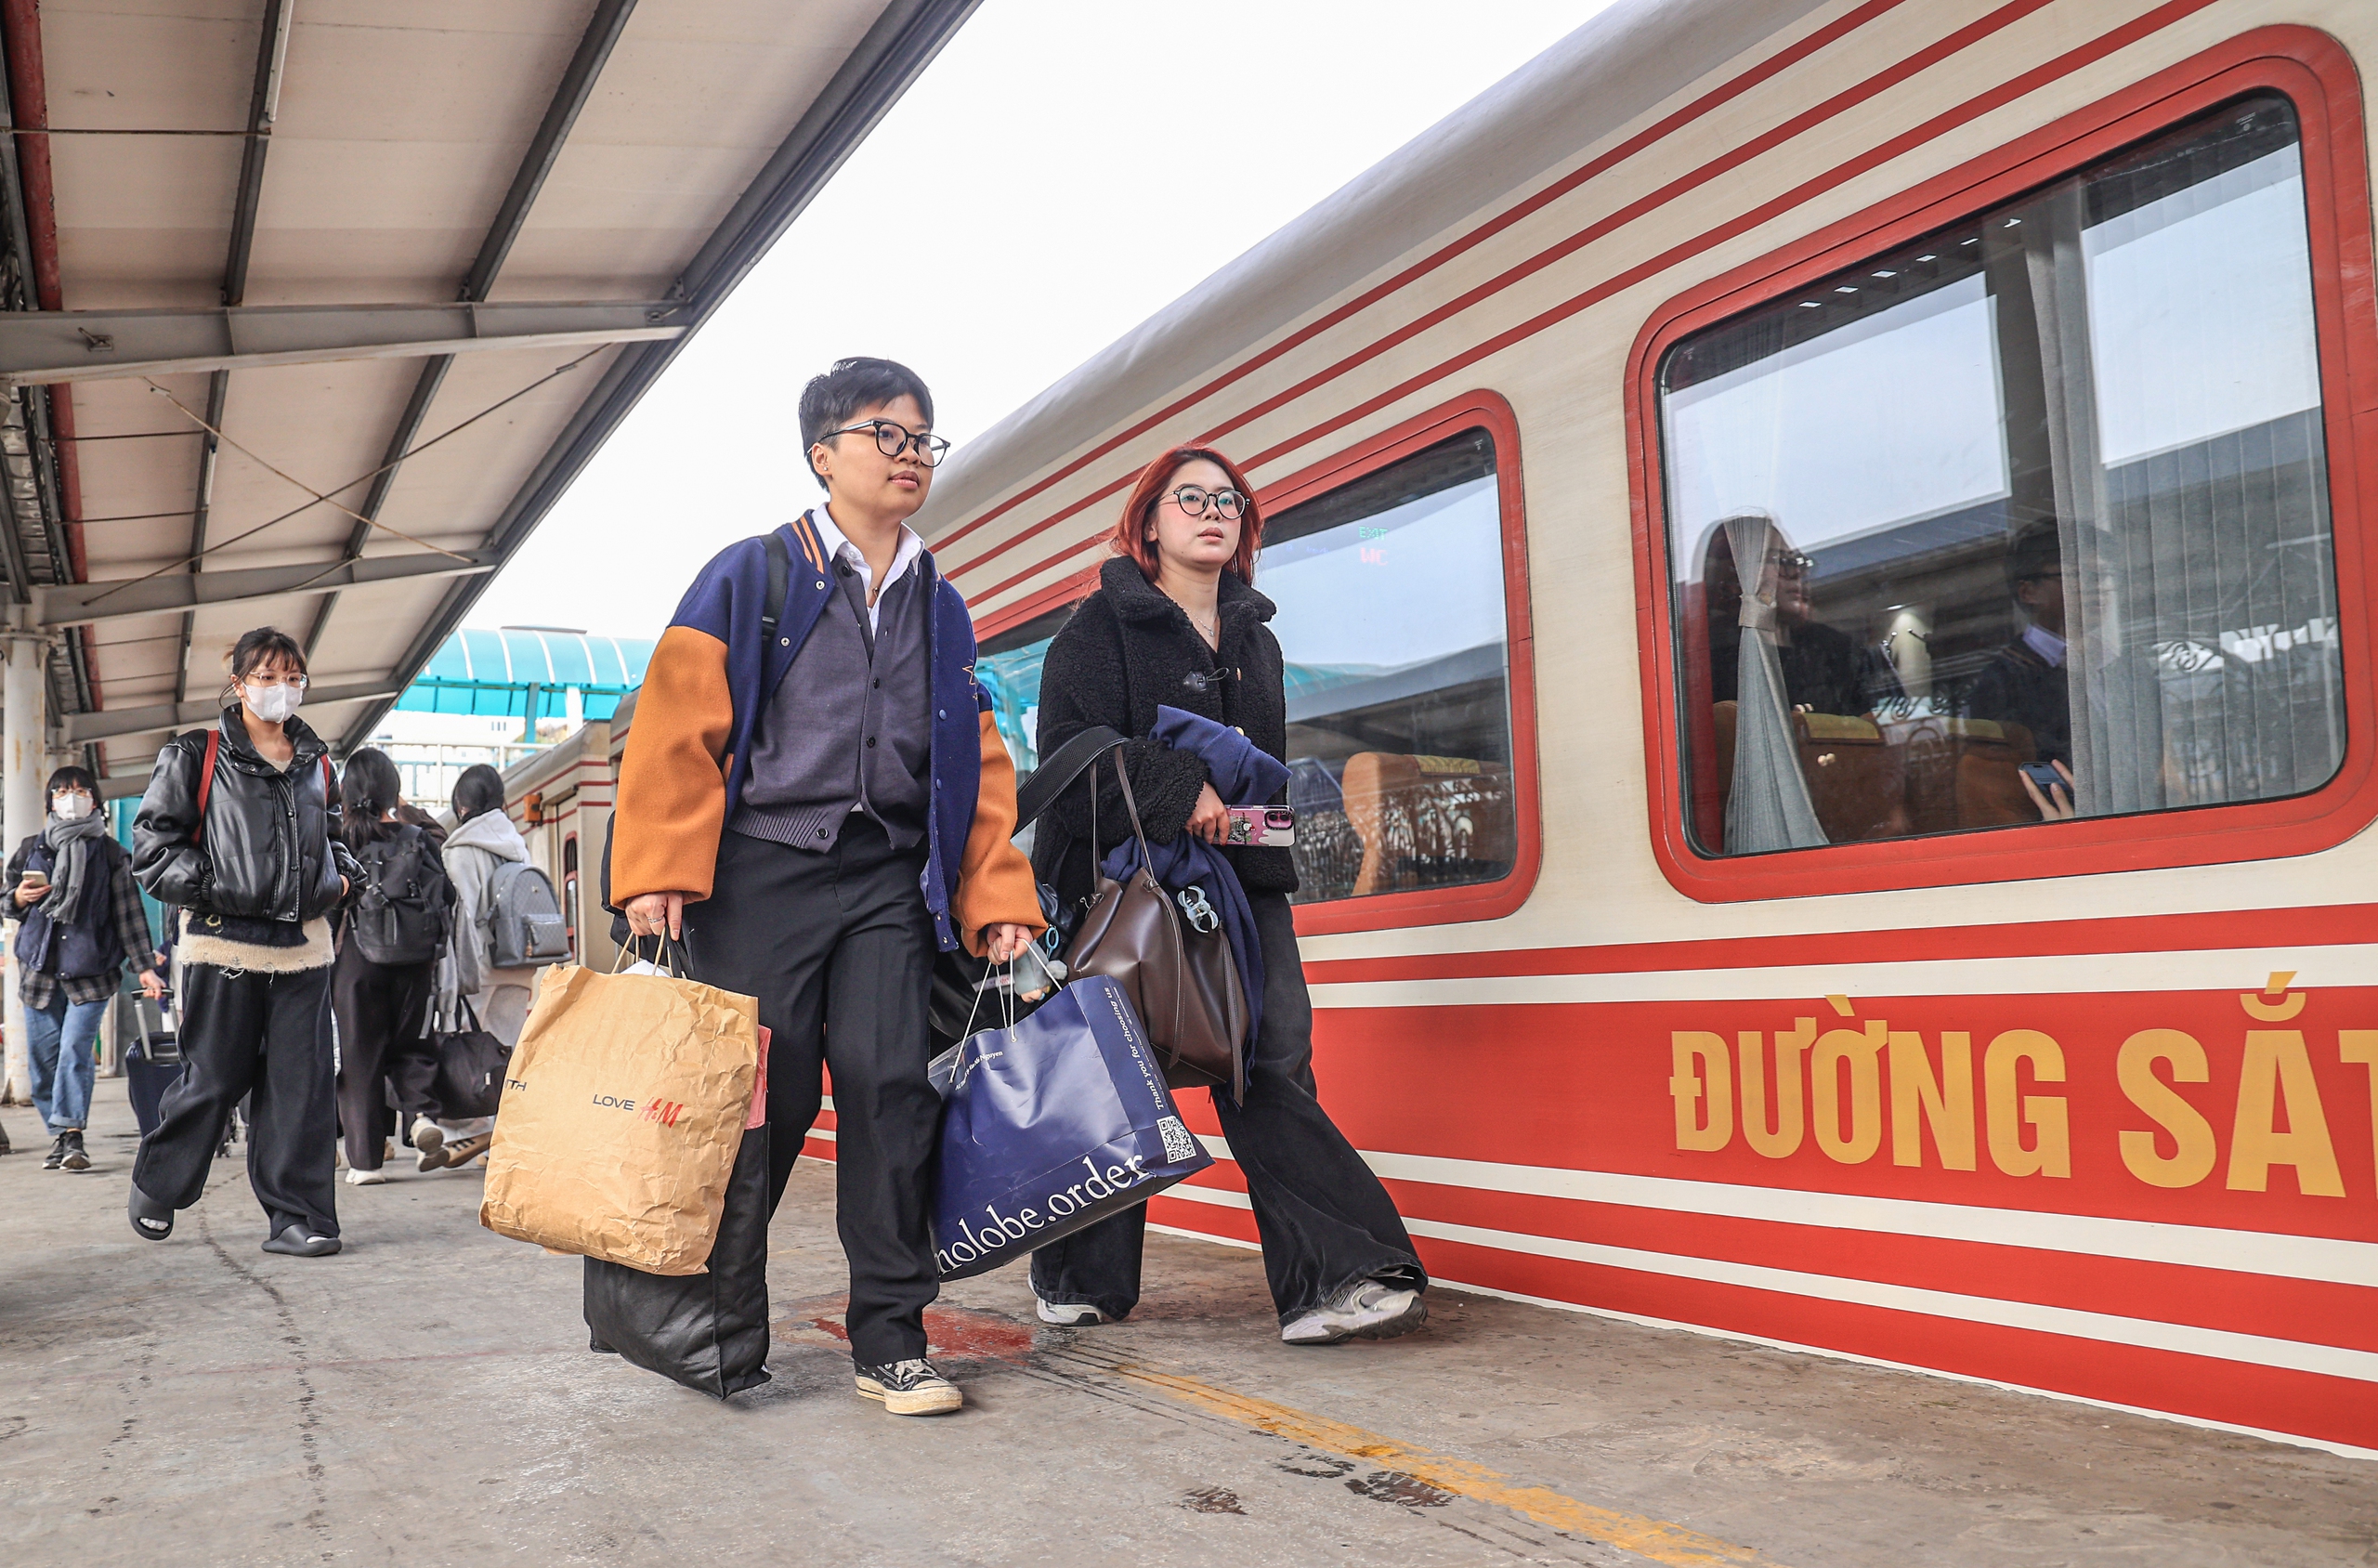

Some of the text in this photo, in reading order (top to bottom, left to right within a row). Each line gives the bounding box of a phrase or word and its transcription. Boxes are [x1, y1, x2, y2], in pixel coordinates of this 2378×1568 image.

[1359, 526, 1389, 540] EXIT
[1360, 547, 1389, 566] WC
[1104, 987, 1113, 999] us
[1110, 1000, 1133, 1041] choosing
[1130, 1044, 1141, 1058] for
[1137, 1060, 1152, 1078] you
[504, 1078, 528, 1091] ITH
[1669, 994, 2072, 1178] ĐƯỜNG
[1145, 1079, 1165, 1110] Thank
[593, 1094, 684, 1129] LOVE H&M
